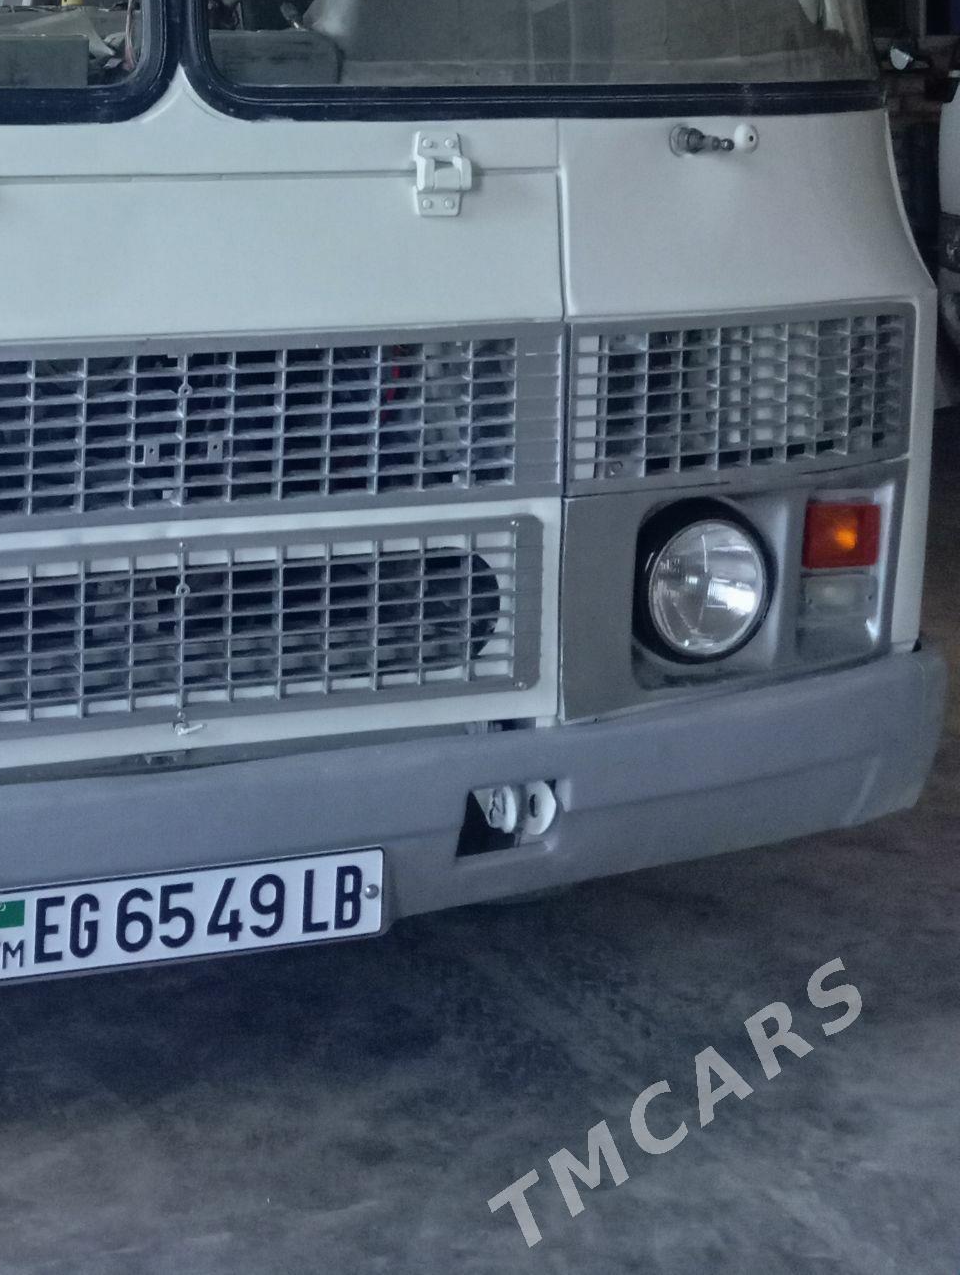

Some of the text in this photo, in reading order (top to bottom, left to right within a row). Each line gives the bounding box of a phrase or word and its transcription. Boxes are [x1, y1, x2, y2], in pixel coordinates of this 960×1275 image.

[34, 865, 364, 965] EG 6549 LB
